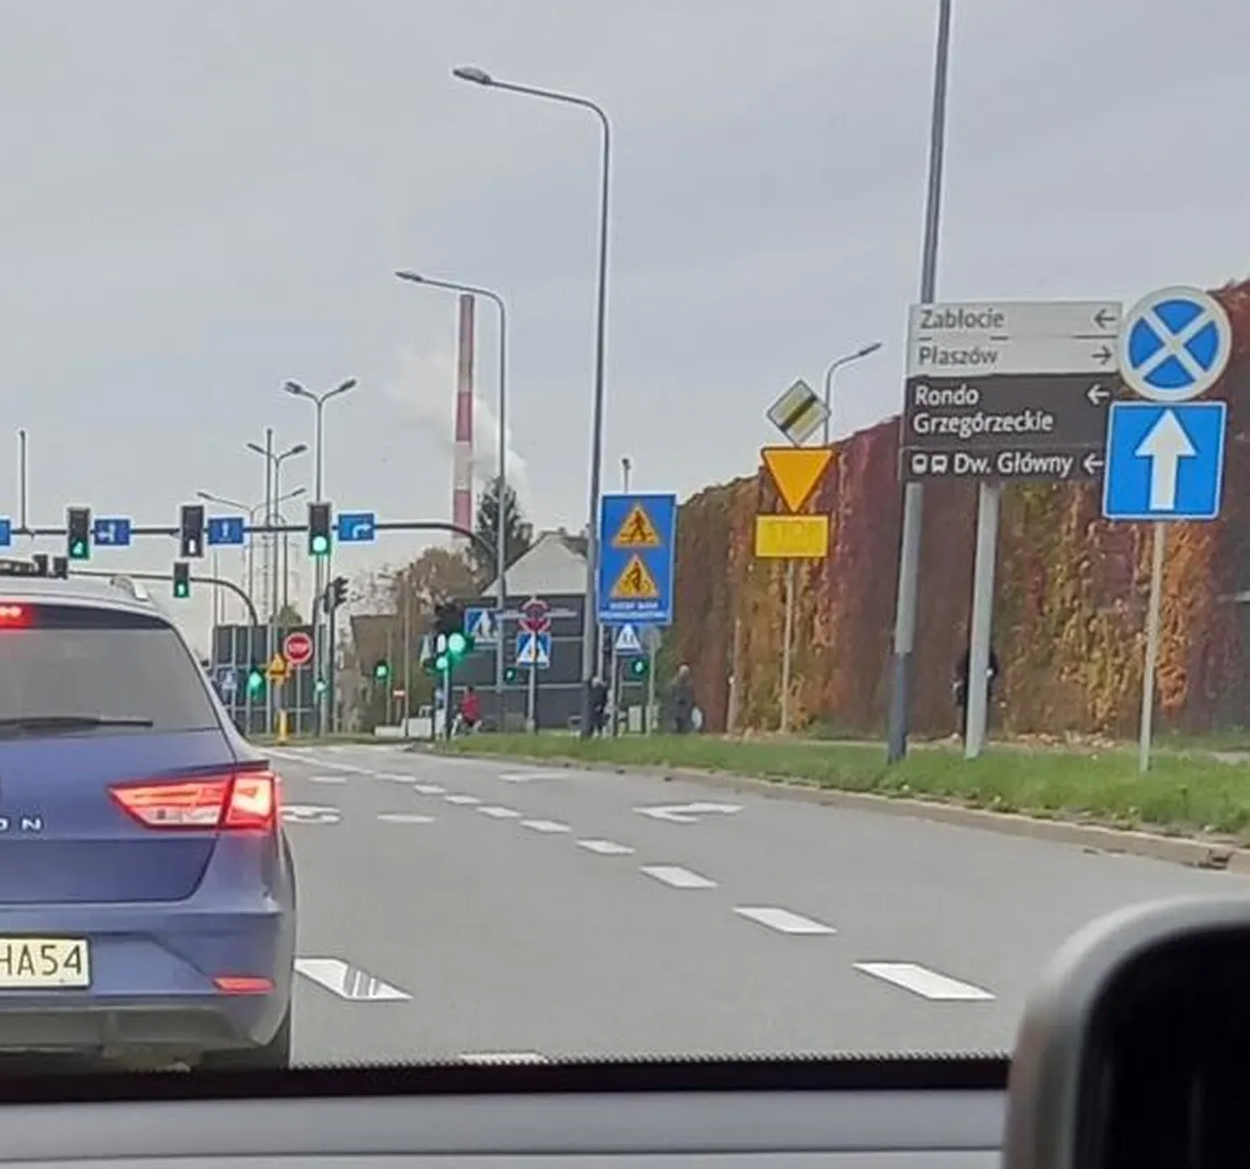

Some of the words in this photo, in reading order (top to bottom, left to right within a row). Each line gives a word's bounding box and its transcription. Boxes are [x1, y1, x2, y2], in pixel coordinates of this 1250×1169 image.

[919, 307, 1005, 329] Zabłocie
[918, 345, 999, 365] Płaszów
[914, 383, 979, 406] Rondo
[912, 409, 1054, 439] Grzegórzeckie
[953, 453, 992, 474] Dw.
[997, 451, 1074, 479] Główny
